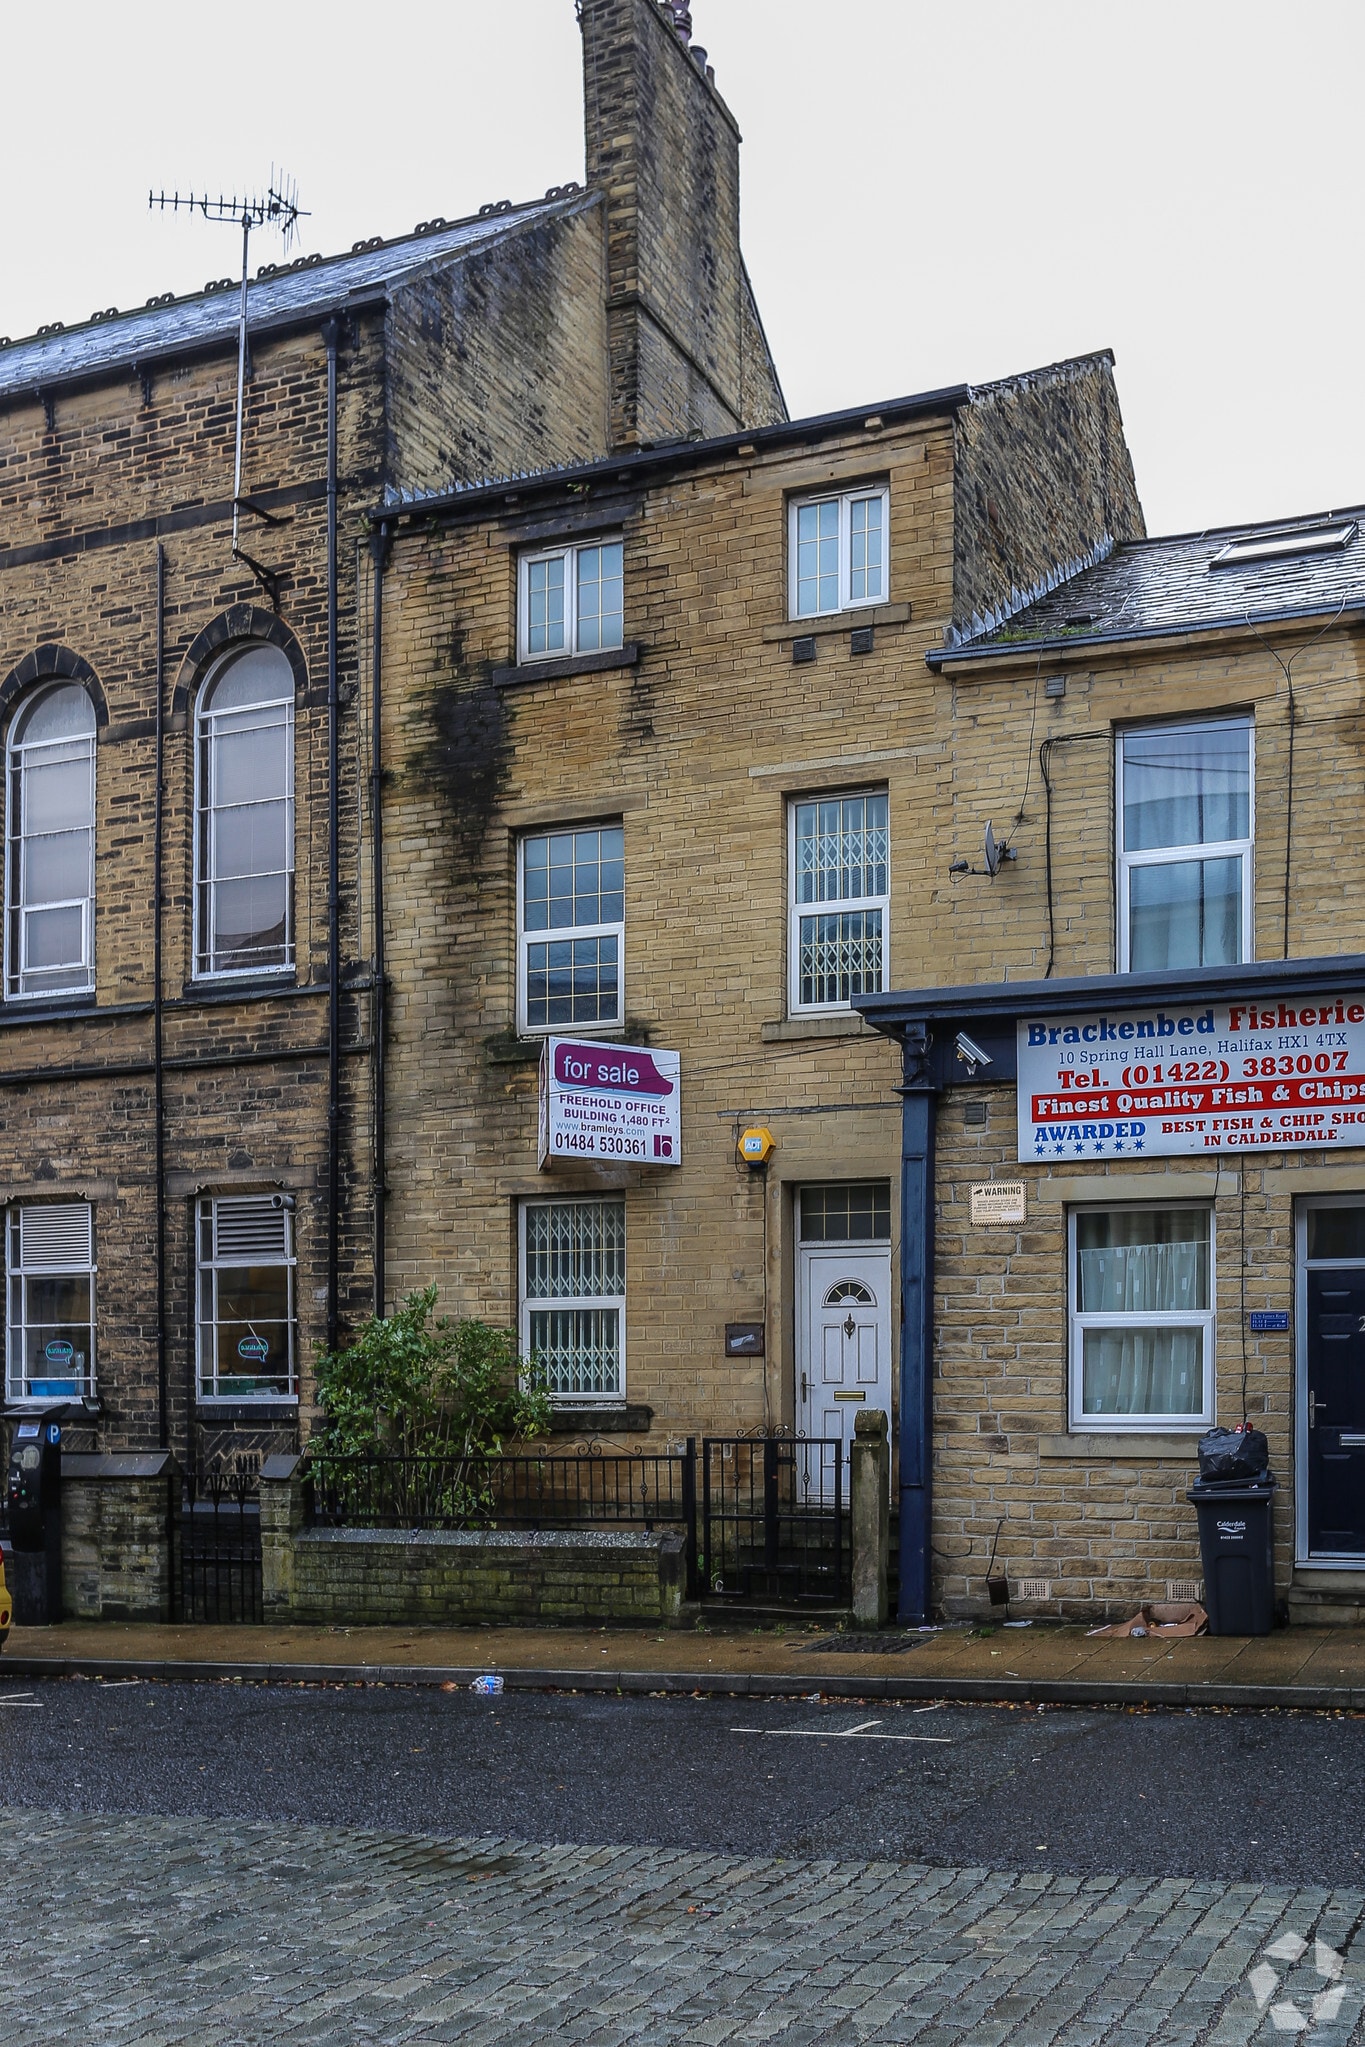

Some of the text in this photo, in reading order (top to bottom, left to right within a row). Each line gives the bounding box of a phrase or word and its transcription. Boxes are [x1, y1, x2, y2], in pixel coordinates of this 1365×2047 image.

[1028, 1009, 1215, 1046] Brackenbed
[1059, 1032, 1347, 1065] 10 Spring Hall Lane, Halifax HX1 4TX
[563, 1055, 639, 1085] for sale
[1058, 1051, 1349, 1089] Tel. (01422) 383007
[559, 1094, 666, 1115] FREEHOLD OFFICE
[1037, 1096, 1109, 1115] Finest
[1117, 1091, 1204, 1113] Quality
[1211, 1086, 1263, 1105] Fish
[1271, 1084, 1290, 1101] &
[564, 1108, 617, 1123] BUILDING
[620, 1114, 649, 1126] 1,480
[1162, 1120, 1206, 1133] BEST
[1212, 1117, 1254, 1131] FISH
[1260, 1116, 1273, 1129] &
[1279, 1113, 1325, 1127] CHIP
[556, 1121, 645, 1136] www.bramleys.com
[1034, 1121, 1146, 1142] AWARDED
[1204, 1129, 1338, 1146] IN CALDERDALE
[555, 1132, 646, 1155] 01484 530361
[984, 1186, 1021, 1196] WARNING
[50, 1424, 59, 1443] P
